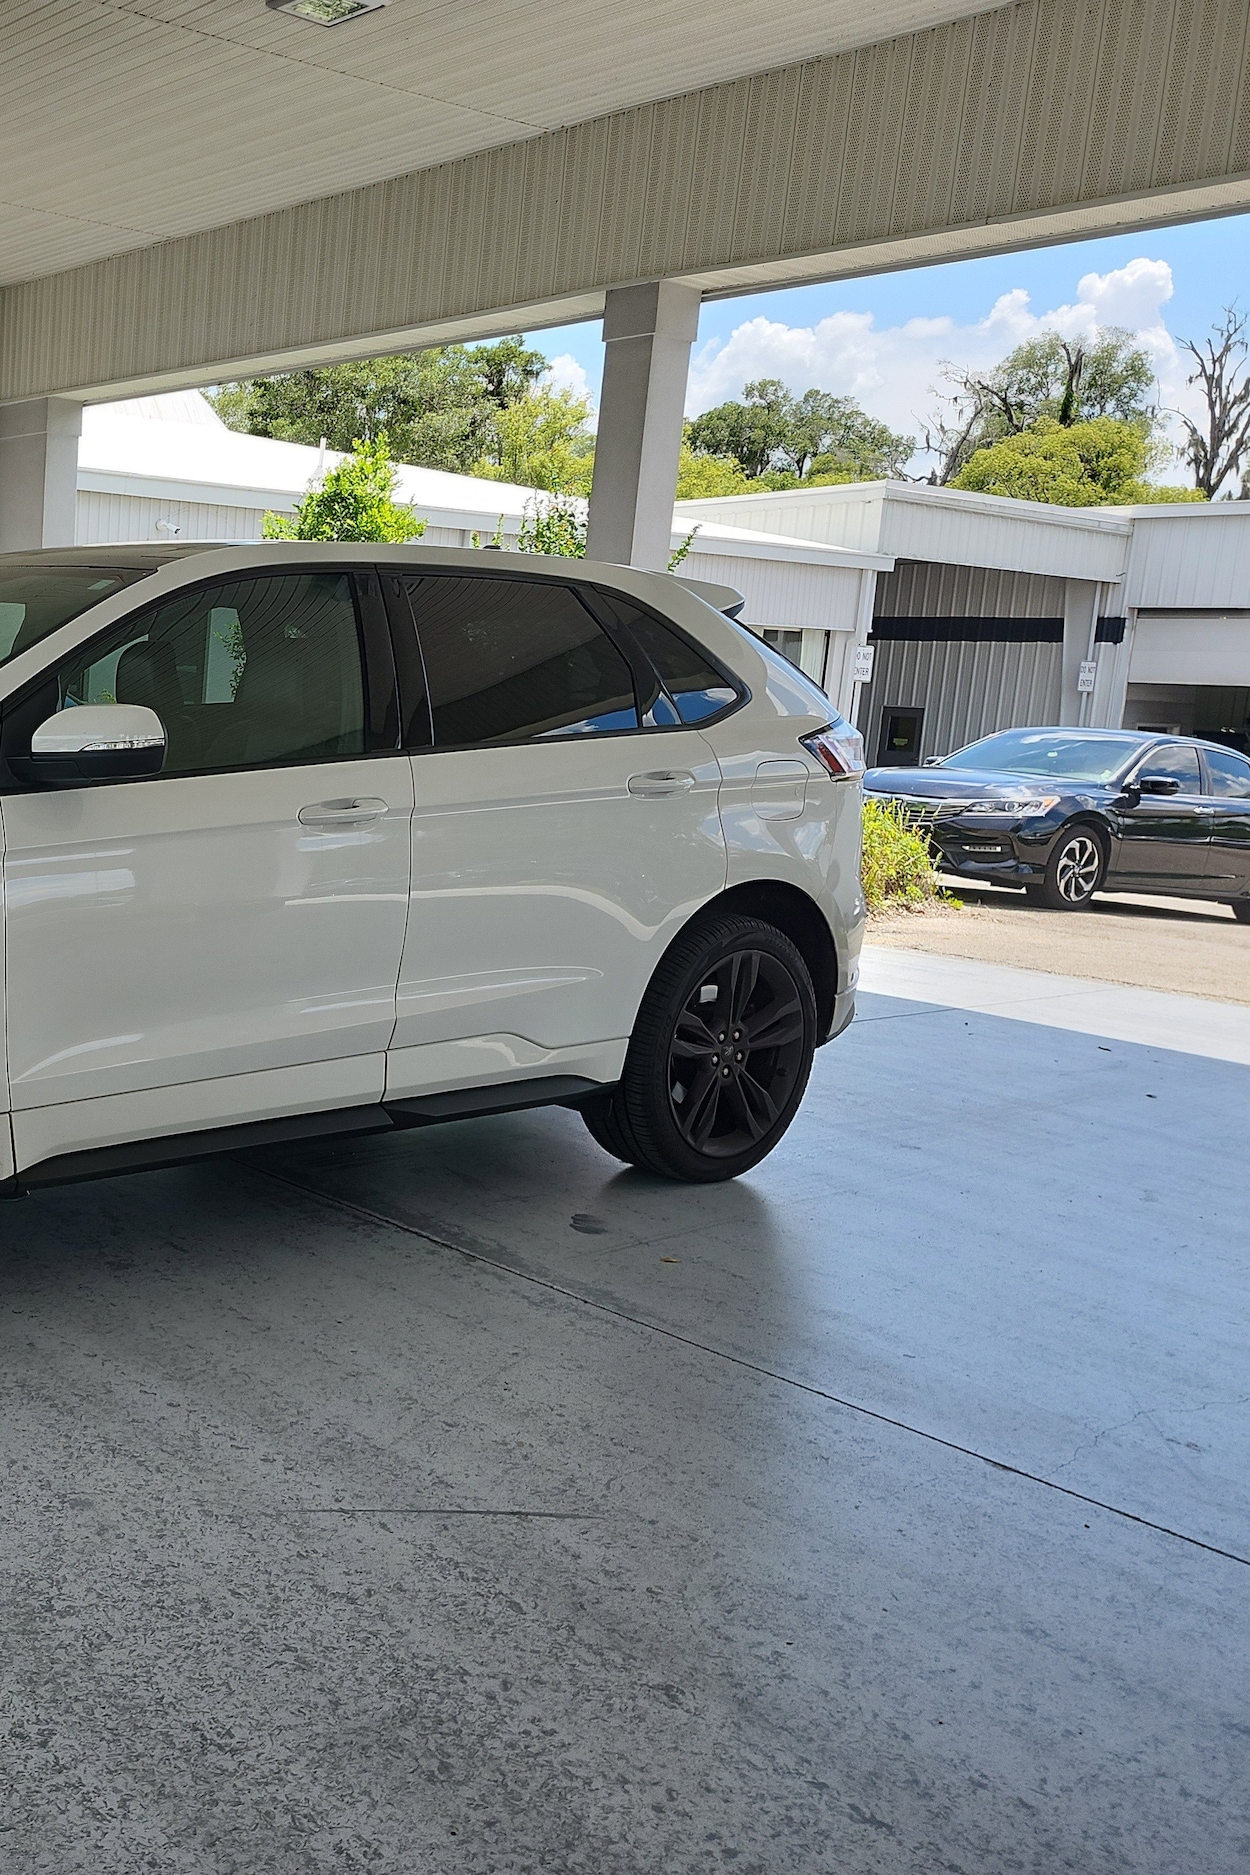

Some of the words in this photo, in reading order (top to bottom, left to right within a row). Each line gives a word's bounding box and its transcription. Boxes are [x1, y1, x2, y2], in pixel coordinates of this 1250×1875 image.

[862, 653, 872, 661] NOT
[1080, 665, 1087, 674] DO
[1088, 666, 1096, 674] NOT
[1080, 679, 1093, 687] ENTER
